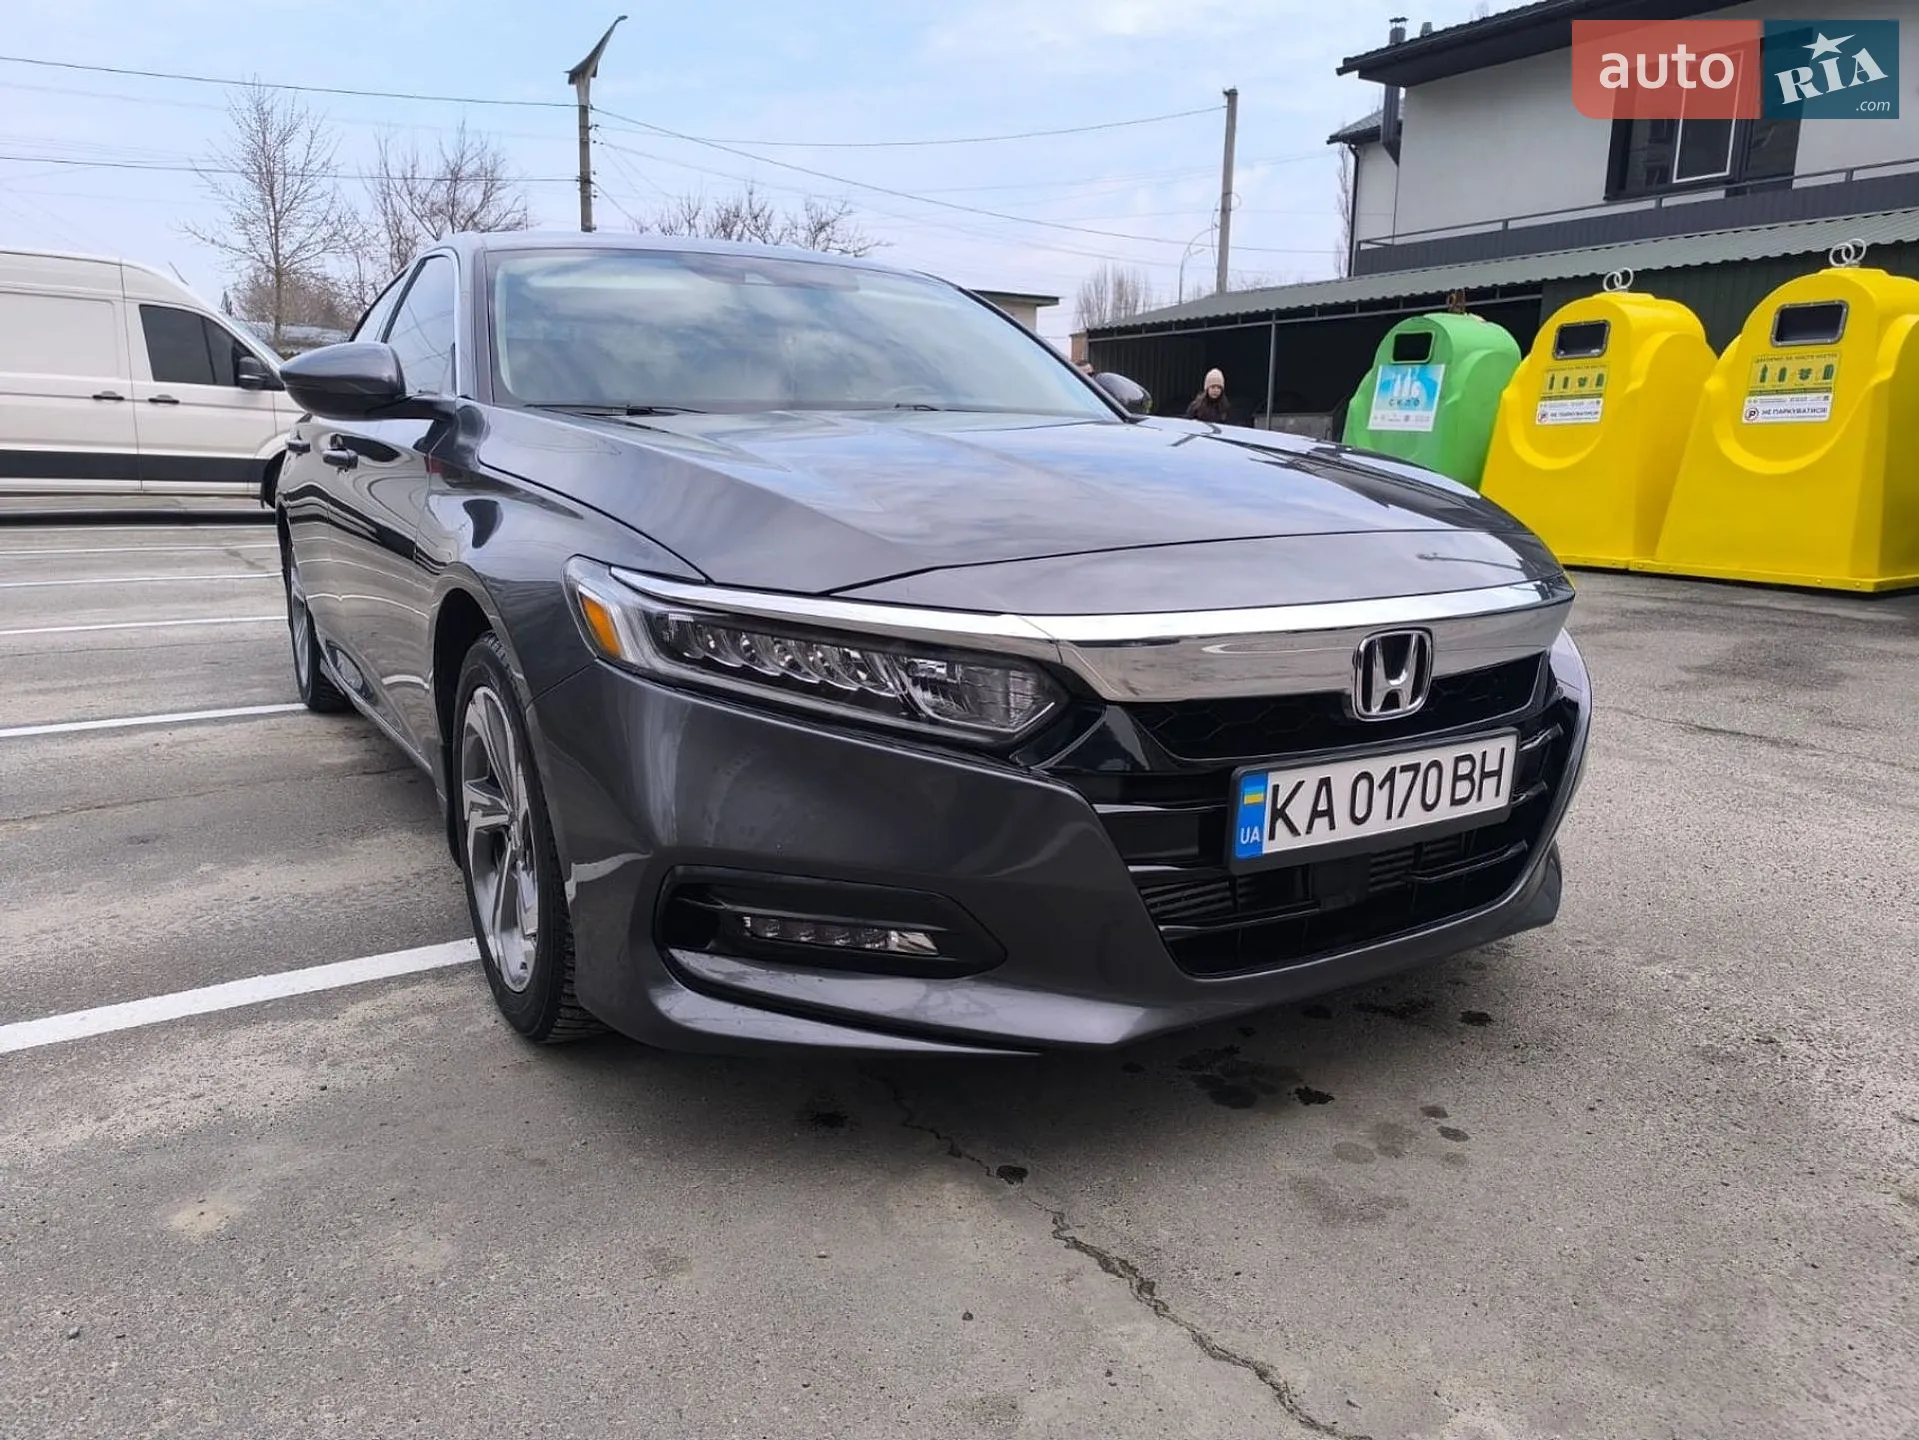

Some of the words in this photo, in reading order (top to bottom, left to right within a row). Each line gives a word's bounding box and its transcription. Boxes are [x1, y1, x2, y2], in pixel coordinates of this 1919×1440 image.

[1268, 776, 1336, 841] KA
[1350, 759, 1443, 826] 0170
[1449, 747, 1506, 806] BH
[1240, 827, 1261, 845] UA
